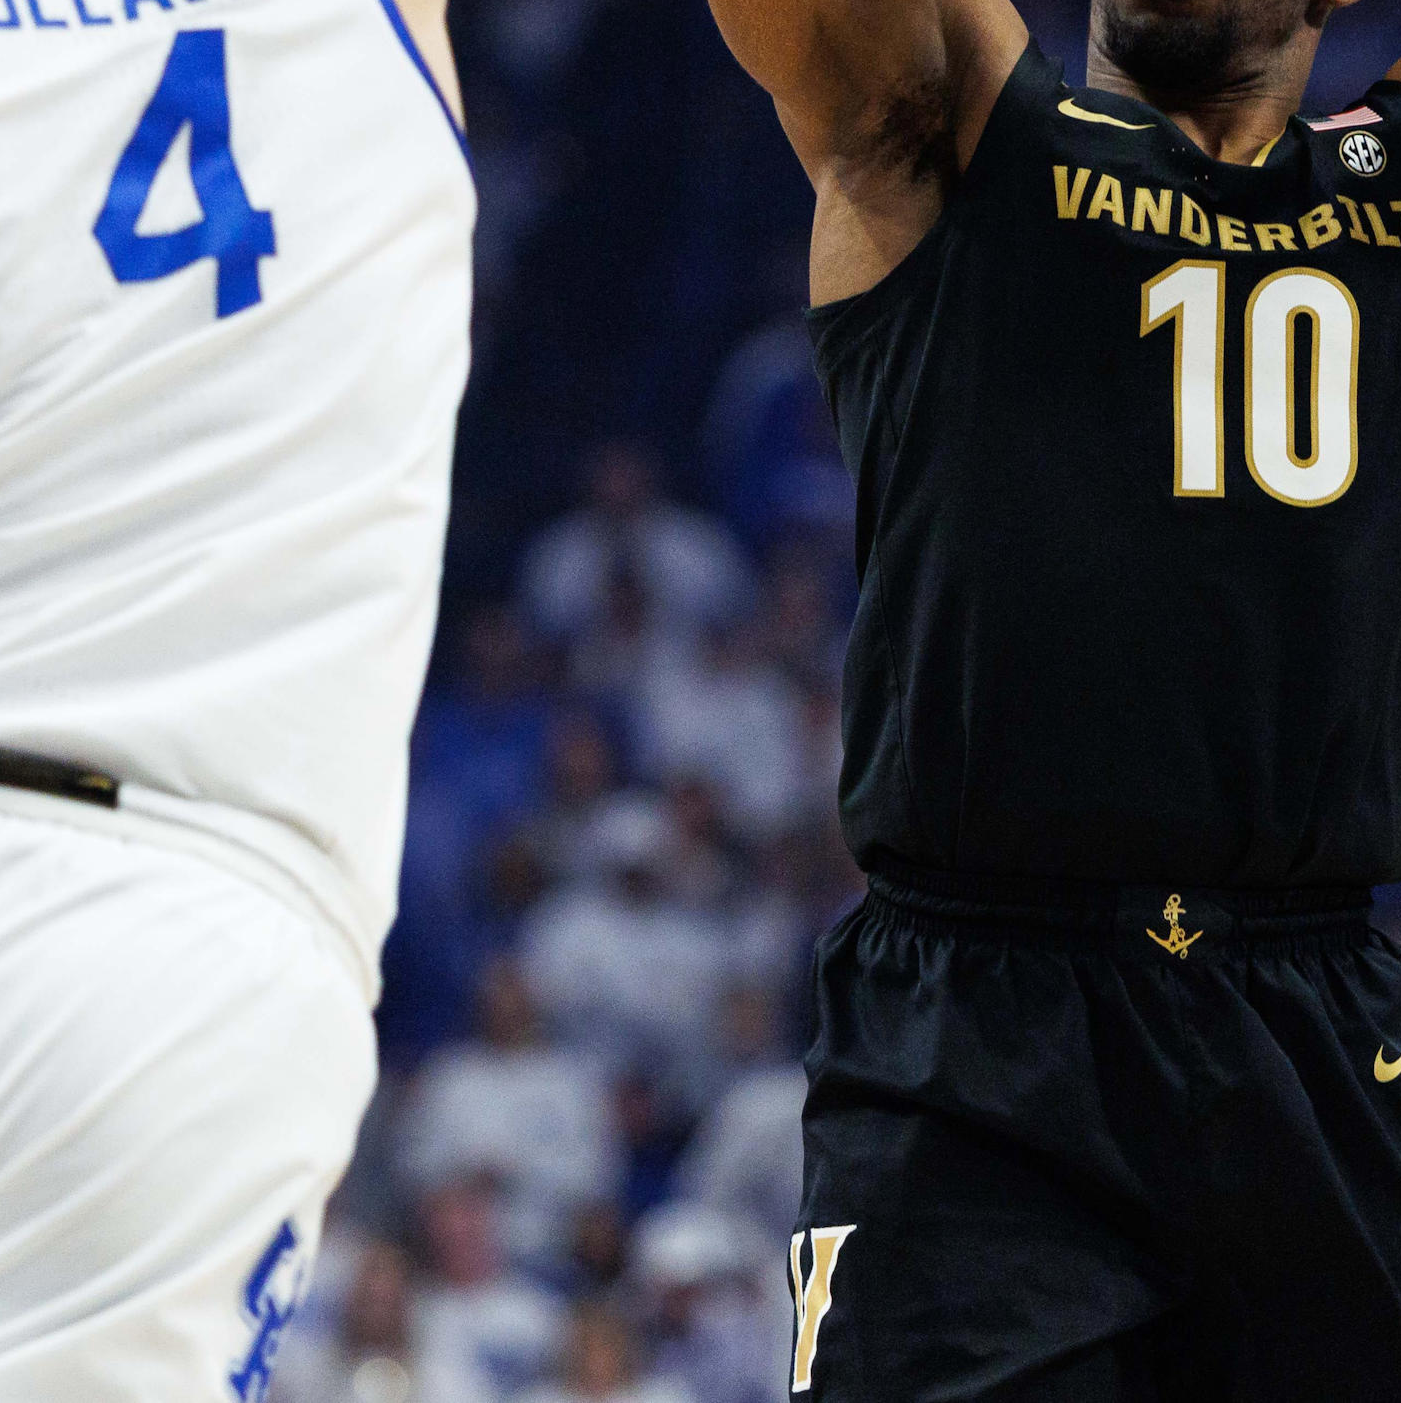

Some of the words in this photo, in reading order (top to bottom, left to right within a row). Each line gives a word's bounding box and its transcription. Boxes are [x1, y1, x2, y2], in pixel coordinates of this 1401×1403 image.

[91, 27, 278, 321] 4
[1342, 134, 1384, 173] SEC
[1139, 258, 1361, 508] 10
